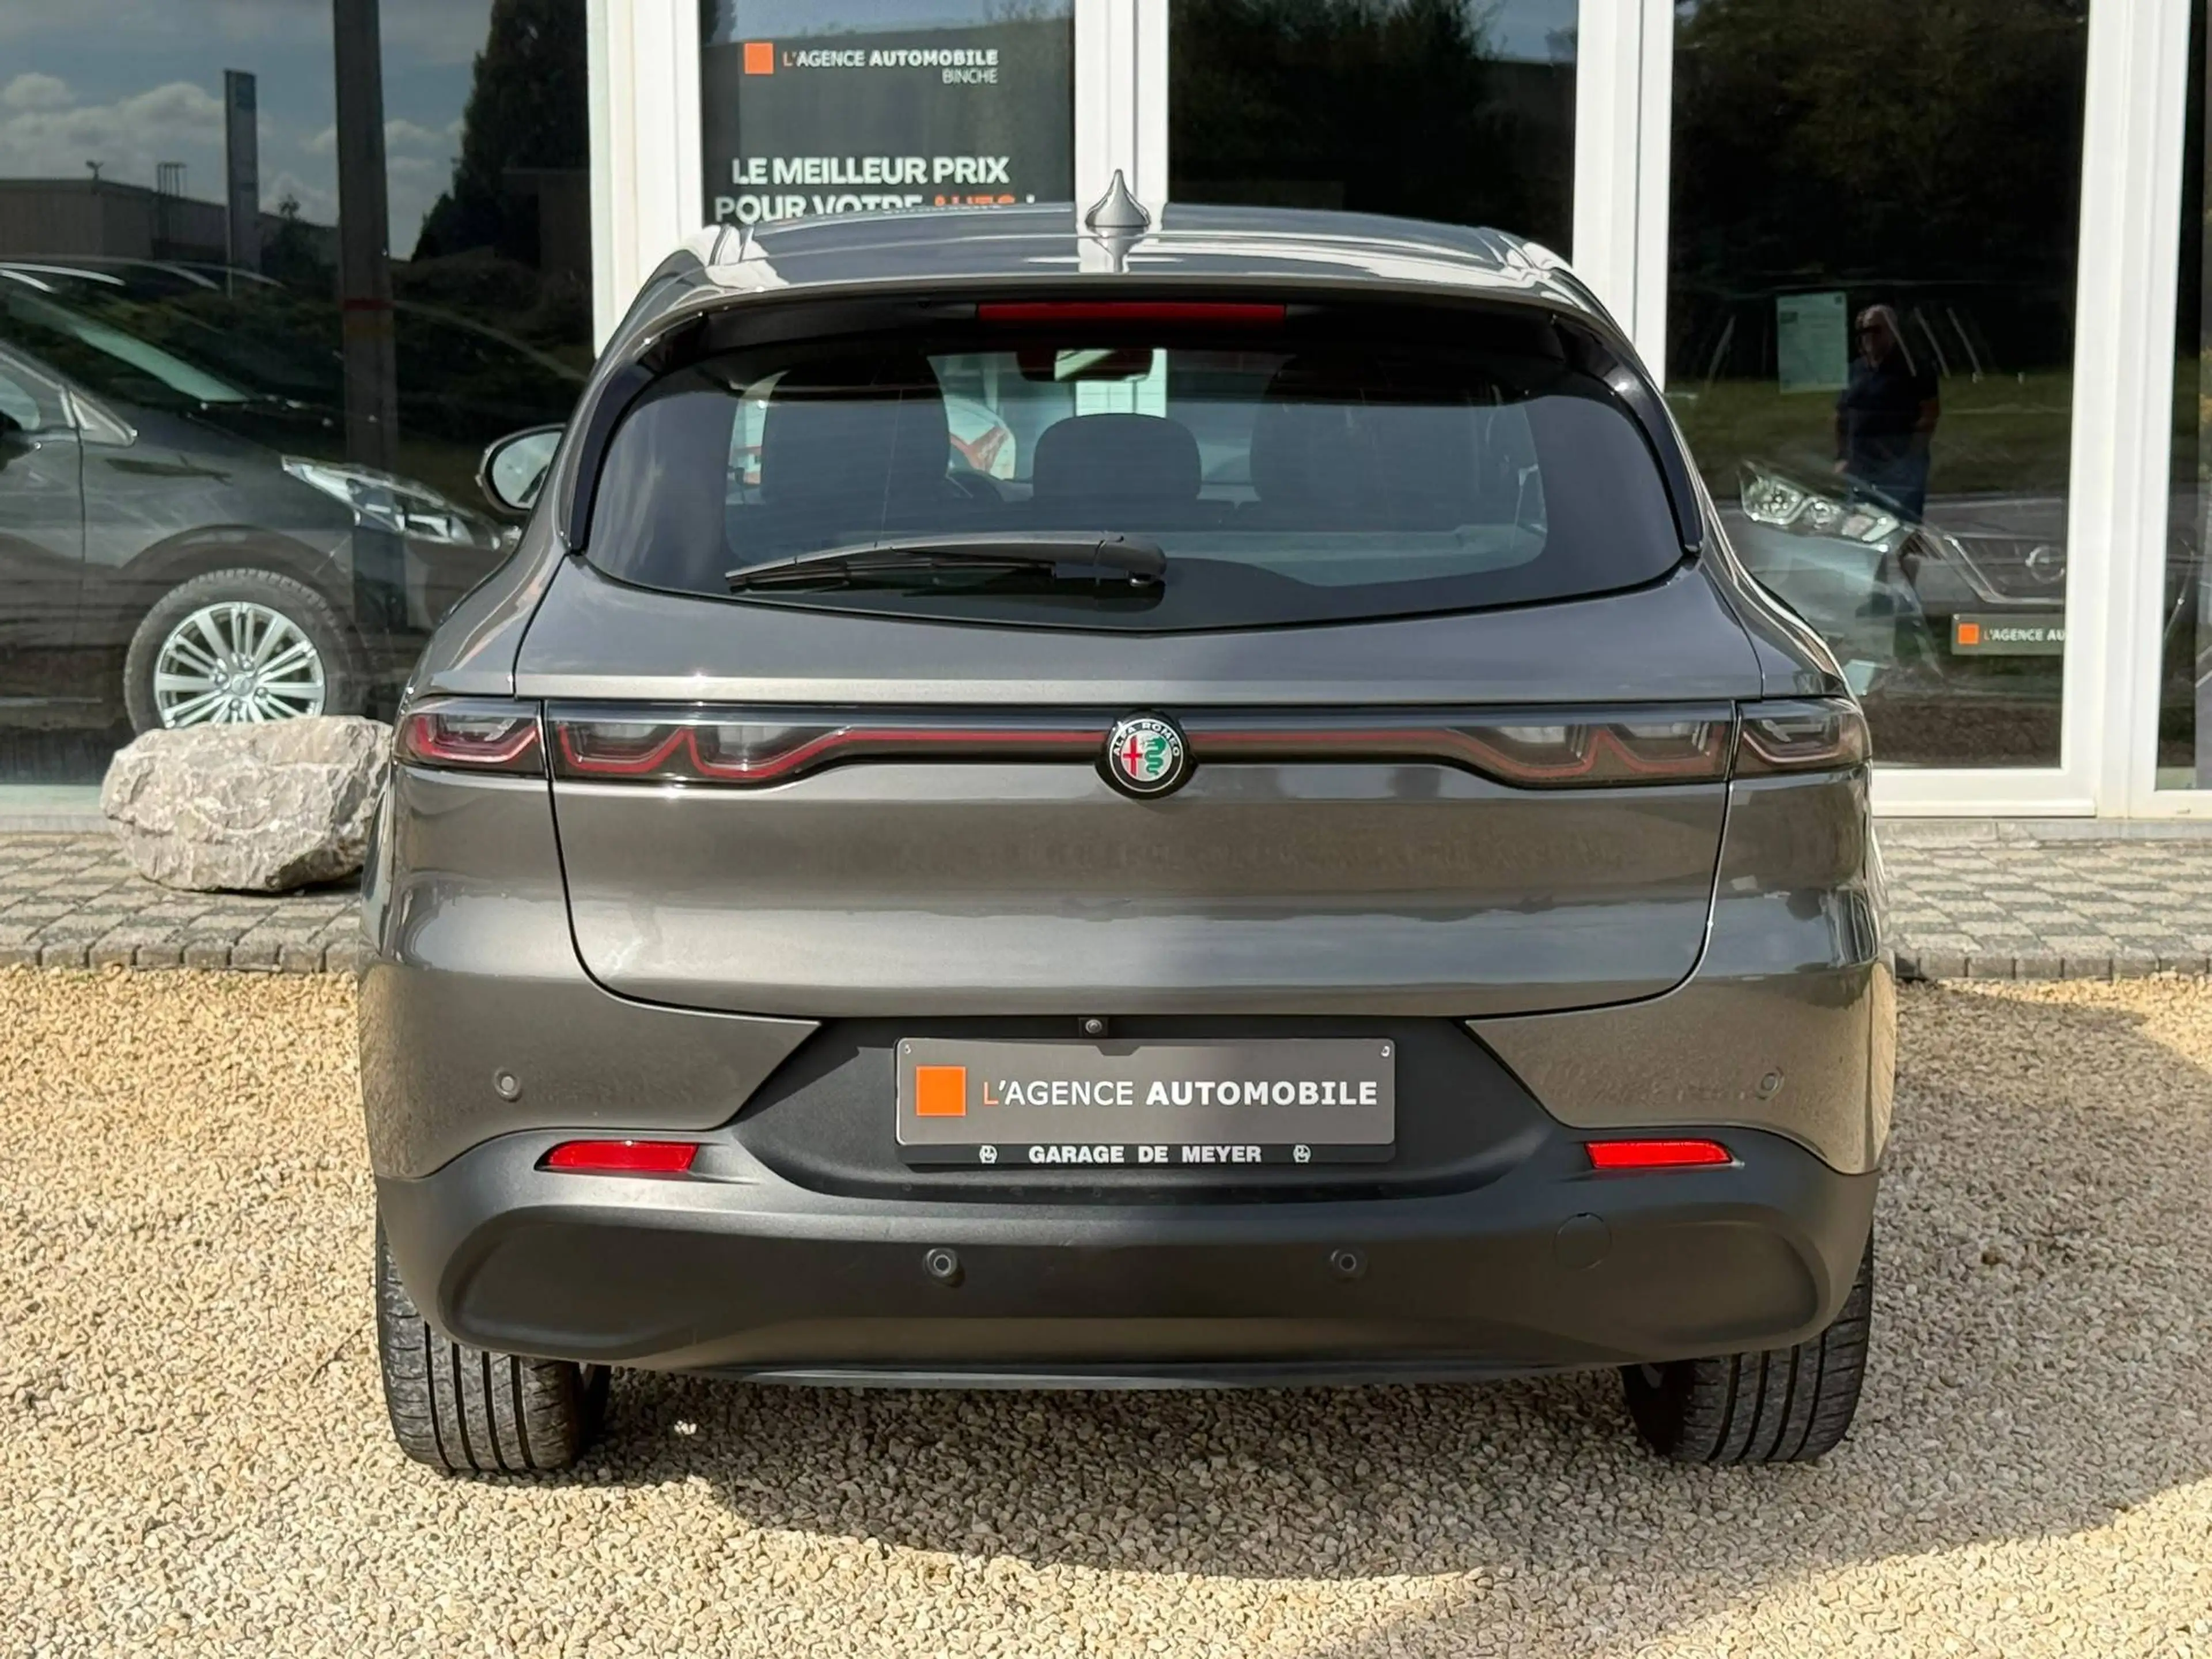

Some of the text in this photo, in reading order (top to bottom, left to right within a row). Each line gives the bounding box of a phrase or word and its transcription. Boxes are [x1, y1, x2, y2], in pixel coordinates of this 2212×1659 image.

[783, 49, 999, 67] L'AGENCE AUTOMOBILE
[942, 68, 998, 84] BINCHE
[732, 156, 1010, 184] LE MEILLEUR PRIX
[714, 194, 807, 224] POUR
[1142, 722, 1180, 757] ROMEO
[983, 1080, 1378, 1105] L'AGENCE AUTOMOBILE
[1028, 1145, 1262, 1164] GARAGE DE MEYER
